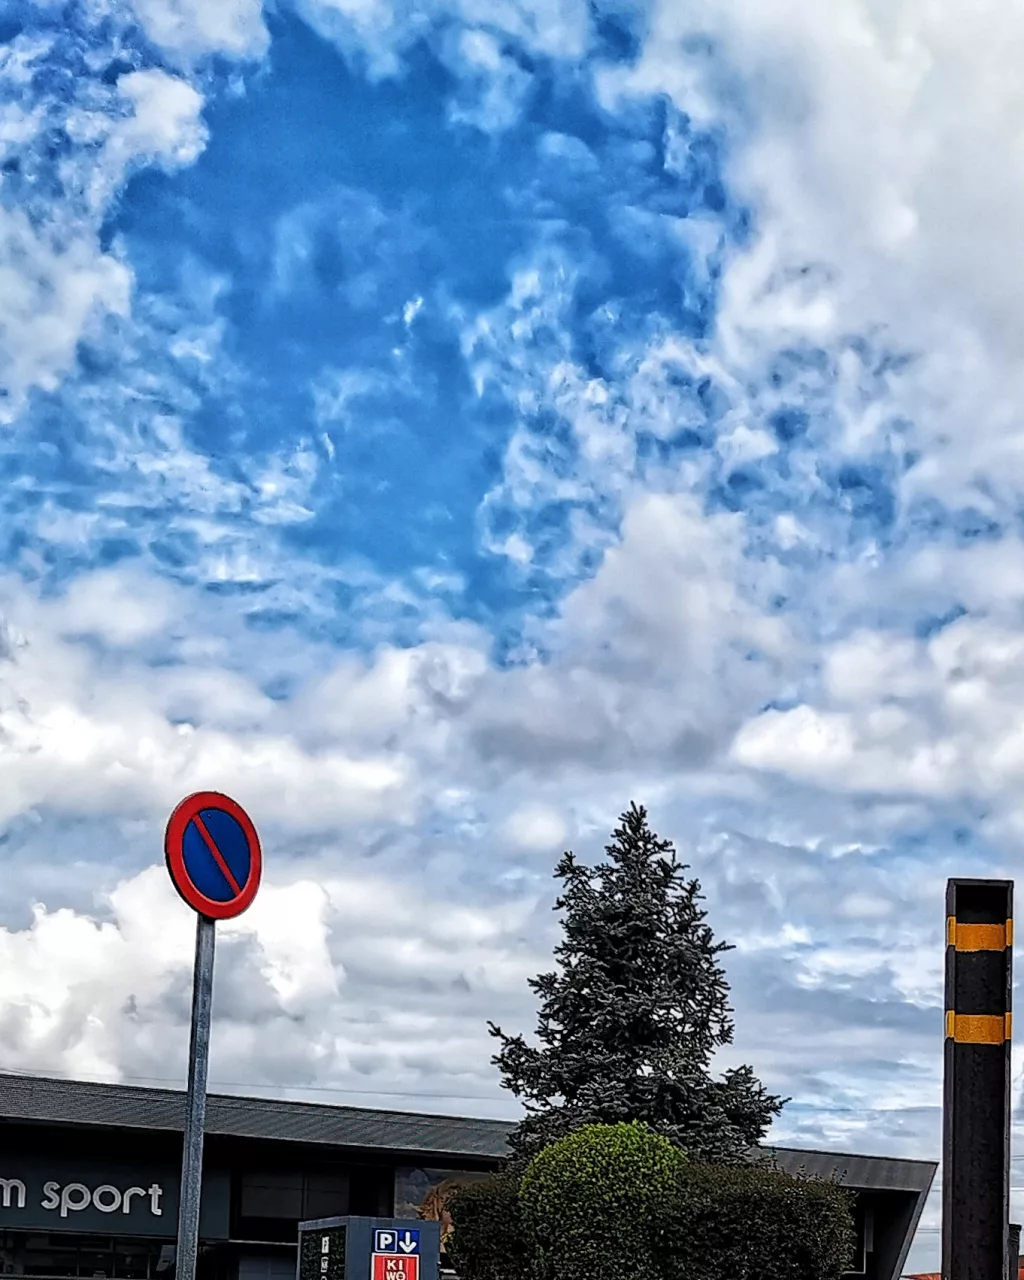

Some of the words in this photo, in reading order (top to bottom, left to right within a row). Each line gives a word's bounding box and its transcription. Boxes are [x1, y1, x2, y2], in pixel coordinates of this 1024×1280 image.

[41, 1181, 163, 1218] sport
[380, 1233, 393, 1249] P
[387, 1259, 403, 1270] KI
[386, 1271, 406, 1280] WO
